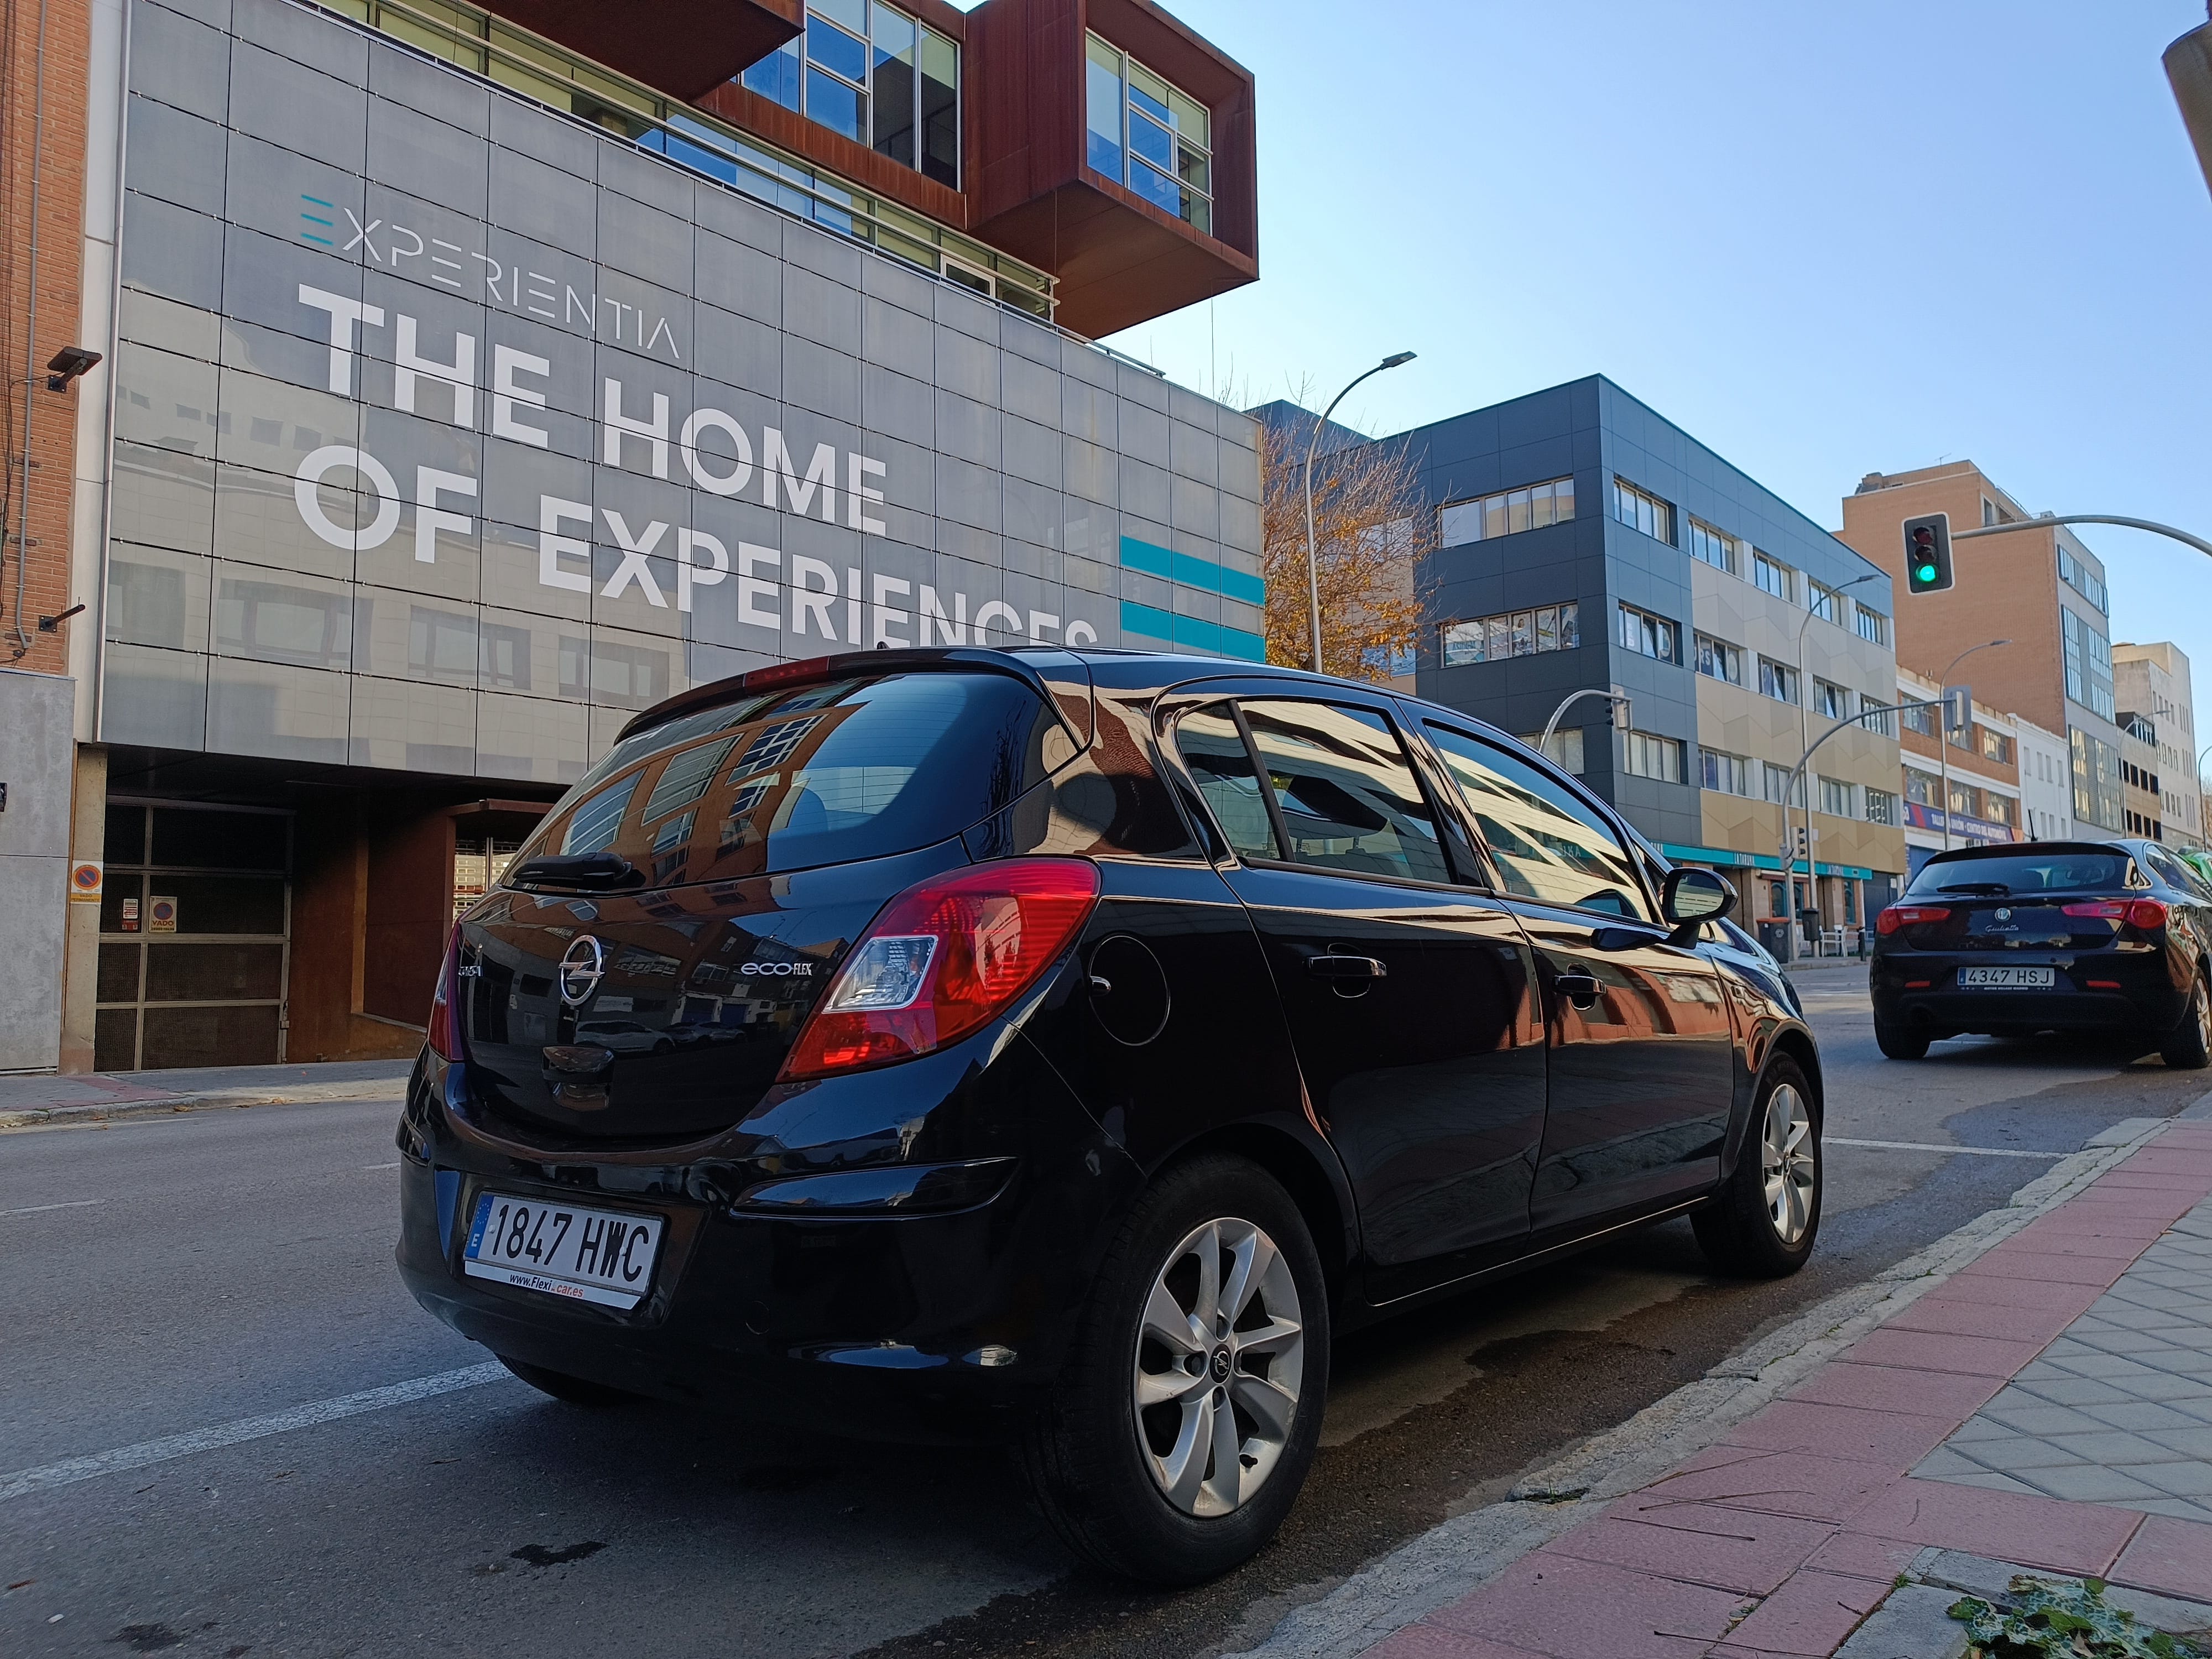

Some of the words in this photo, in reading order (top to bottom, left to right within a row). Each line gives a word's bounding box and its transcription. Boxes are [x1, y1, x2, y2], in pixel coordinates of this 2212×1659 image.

[301, 194, 680, 358] EXPERIENTIA
[299, 283, 550, 448] THE
[604, 377, 886, 537] HOME
[294, 445, 477, 564] OF
[1968, 969, 2011, 983] 4347
[2016, 970, 2049, 984] HSJ
[471, 1233, 480, 1247] E
[492, 1204, 573, 1266] 1847
[575, 1217, 650, 1282] HWC
